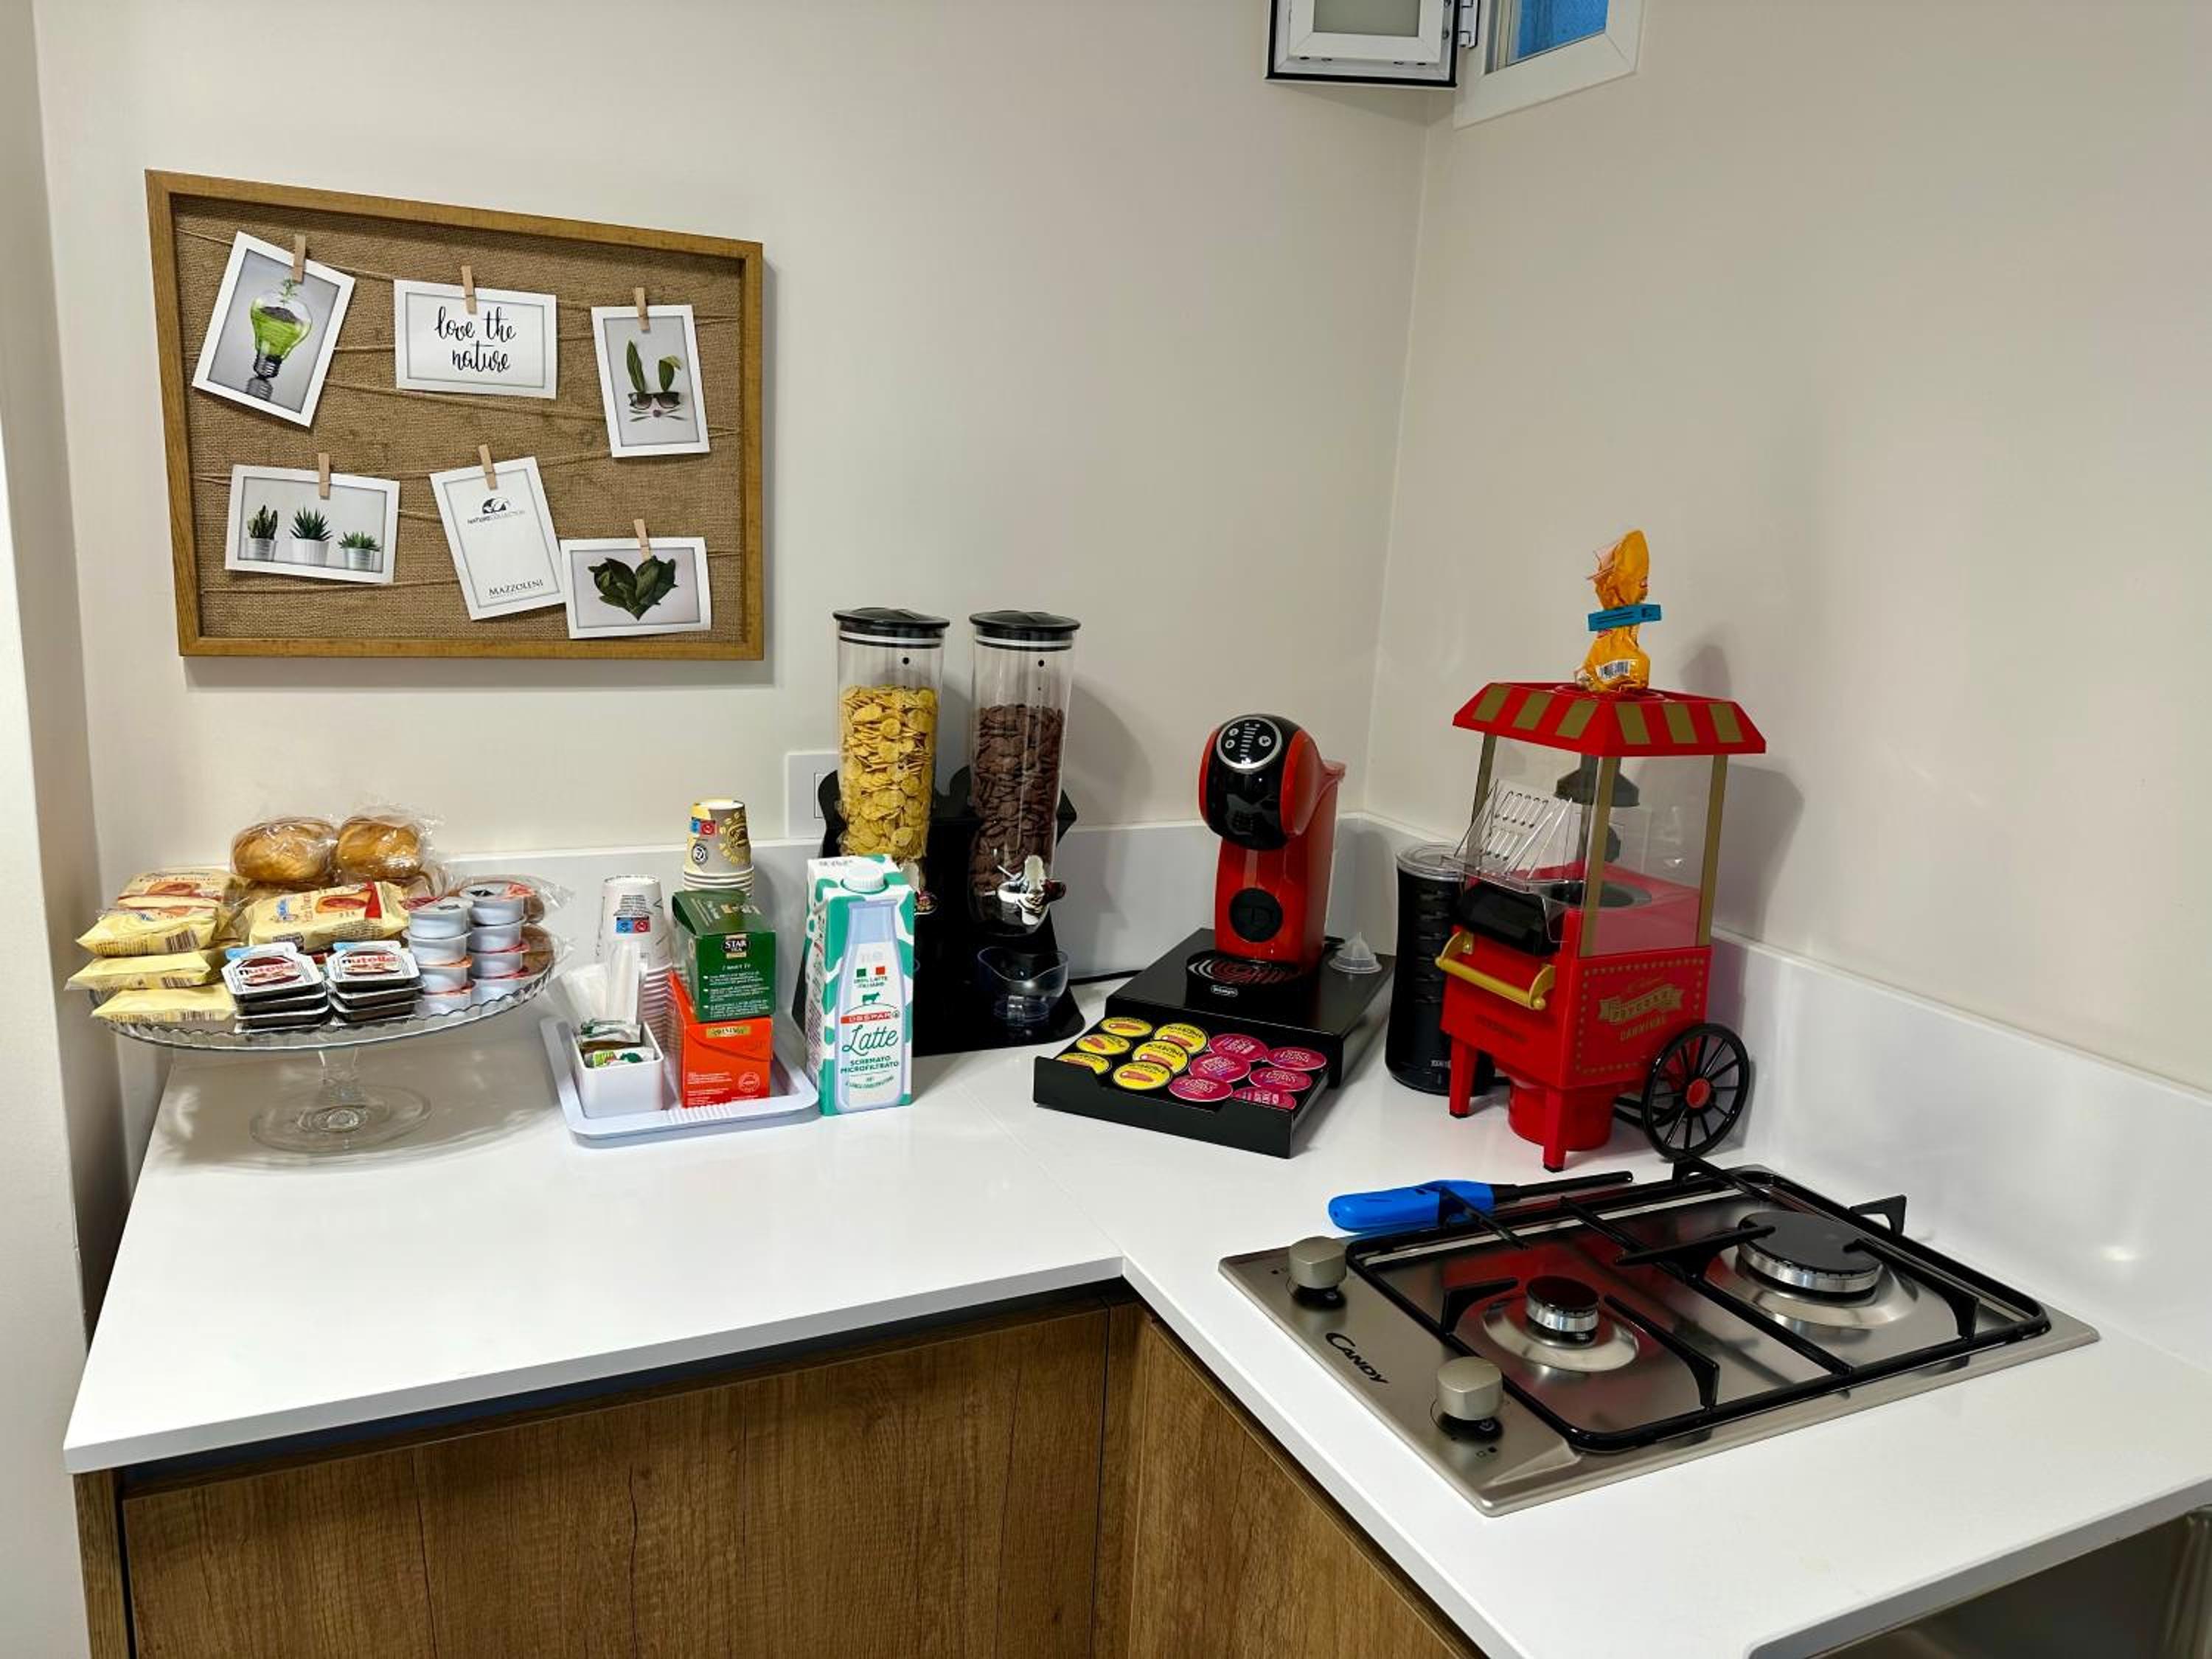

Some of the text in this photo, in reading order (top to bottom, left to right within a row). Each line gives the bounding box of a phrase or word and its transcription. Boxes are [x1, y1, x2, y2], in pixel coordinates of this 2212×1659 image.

[434, 306, 517, 343] love the
[452, 340, 511, 372] nature
[488, 579, 544, 596] MAZZOLENI
[725, 940, 748, 950] STAR
[342, 954, 401, 965] nutella
[238, 961, 297, 975] nutella
[841, 1024, 899, 1057] Latte
[841, 1060, 900, 1074] MICROFILTRATO
[849, 1055, 891, 1066] SCREMATO
[1326, 1333, 1389, 1383] CANDY
